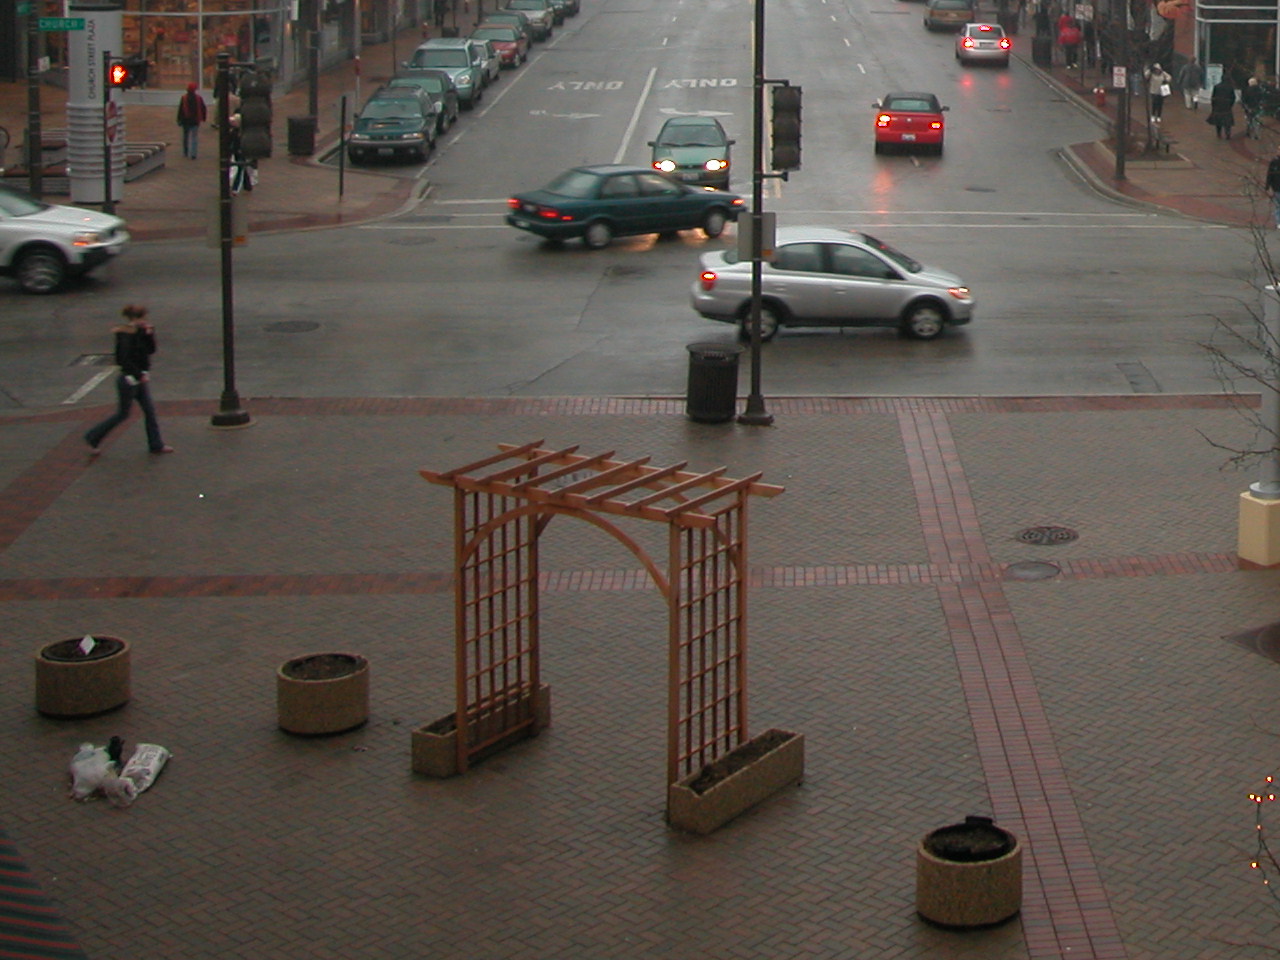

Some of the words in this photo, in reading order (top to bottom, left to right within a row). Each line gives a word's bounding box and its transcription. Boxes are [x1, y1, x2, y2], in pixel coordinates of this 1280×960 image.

[39, 19, 78, 29] CHURCH
[88, 19, 96, 41] PLAZA
[88, 42, 96, 68] STREET
[88, 68, 97, 99] CHURCH
[547, 80, 624, 91] ONLY
[664, 78, 738, 89] ONLY
